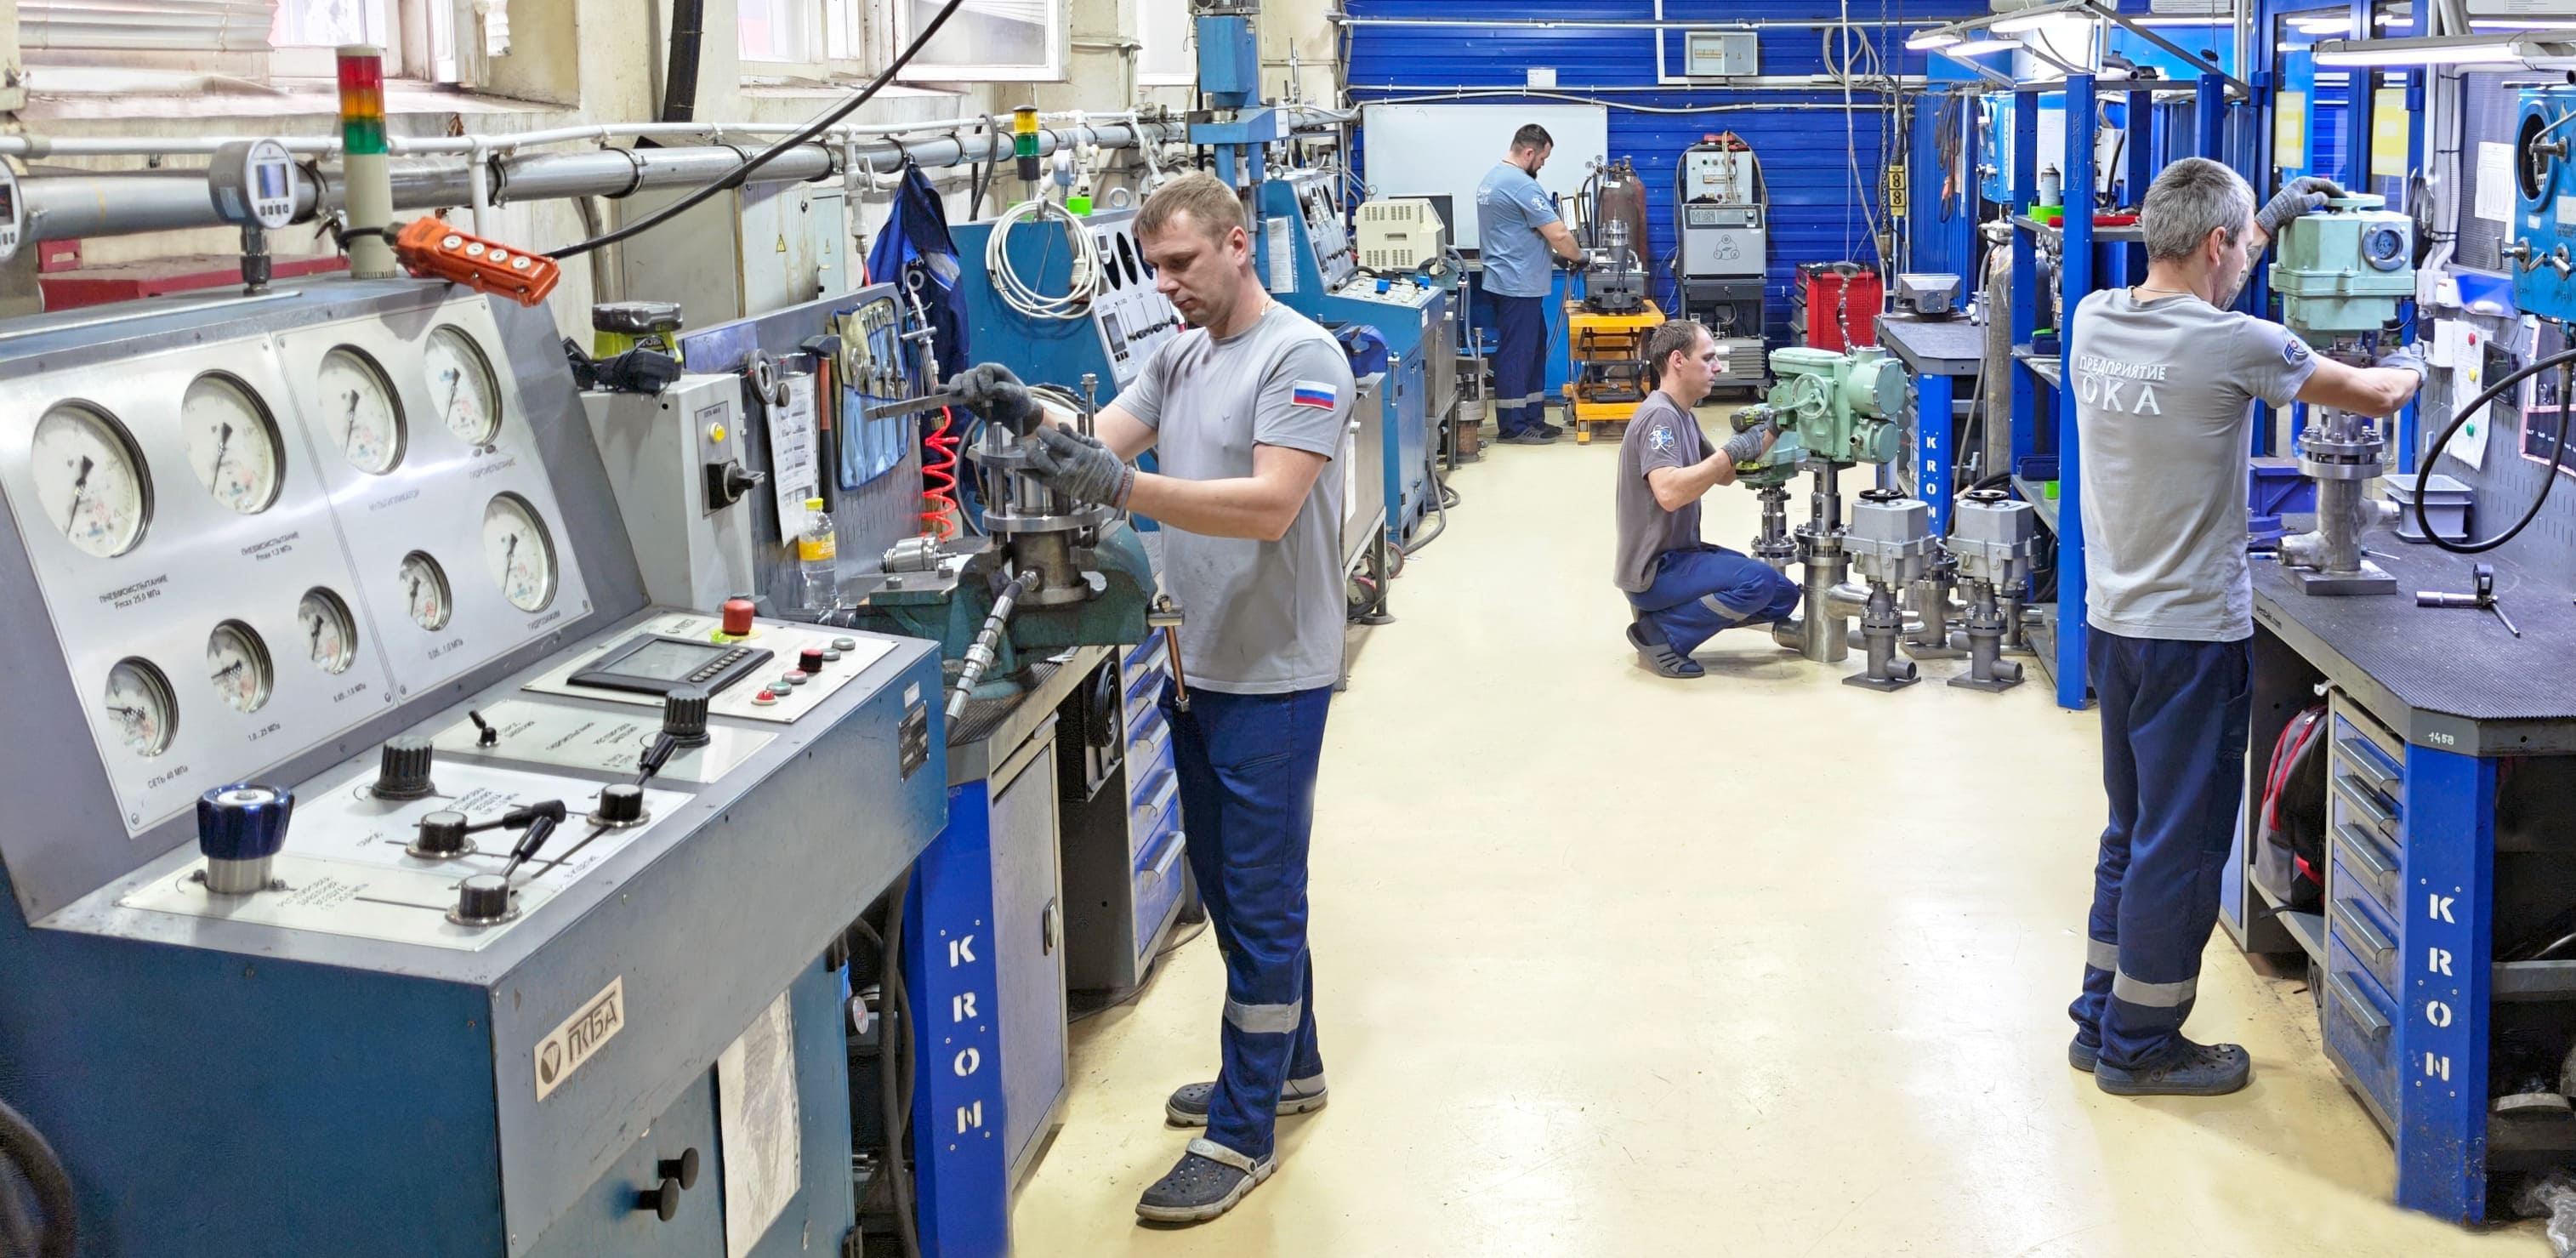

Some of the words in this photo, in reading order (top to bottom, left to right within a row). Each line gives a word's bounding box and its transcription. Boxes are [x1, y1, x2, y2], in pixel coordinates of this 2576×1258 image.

[2078, 356, 2166, 380] ПРЕДПРИЯТИЕ
[2082, 374, 2161, 415] ОКА
[1925, 436, 1937, 518] KRON
[99, 574, 168, 604] ПНЕВМОИСПЫТАНИЕ
[148, 776, 166, 789] СЕТЬ
[2425, 893, 2455, 1082] KRON
[949, 934, 982, 1135] KRON
